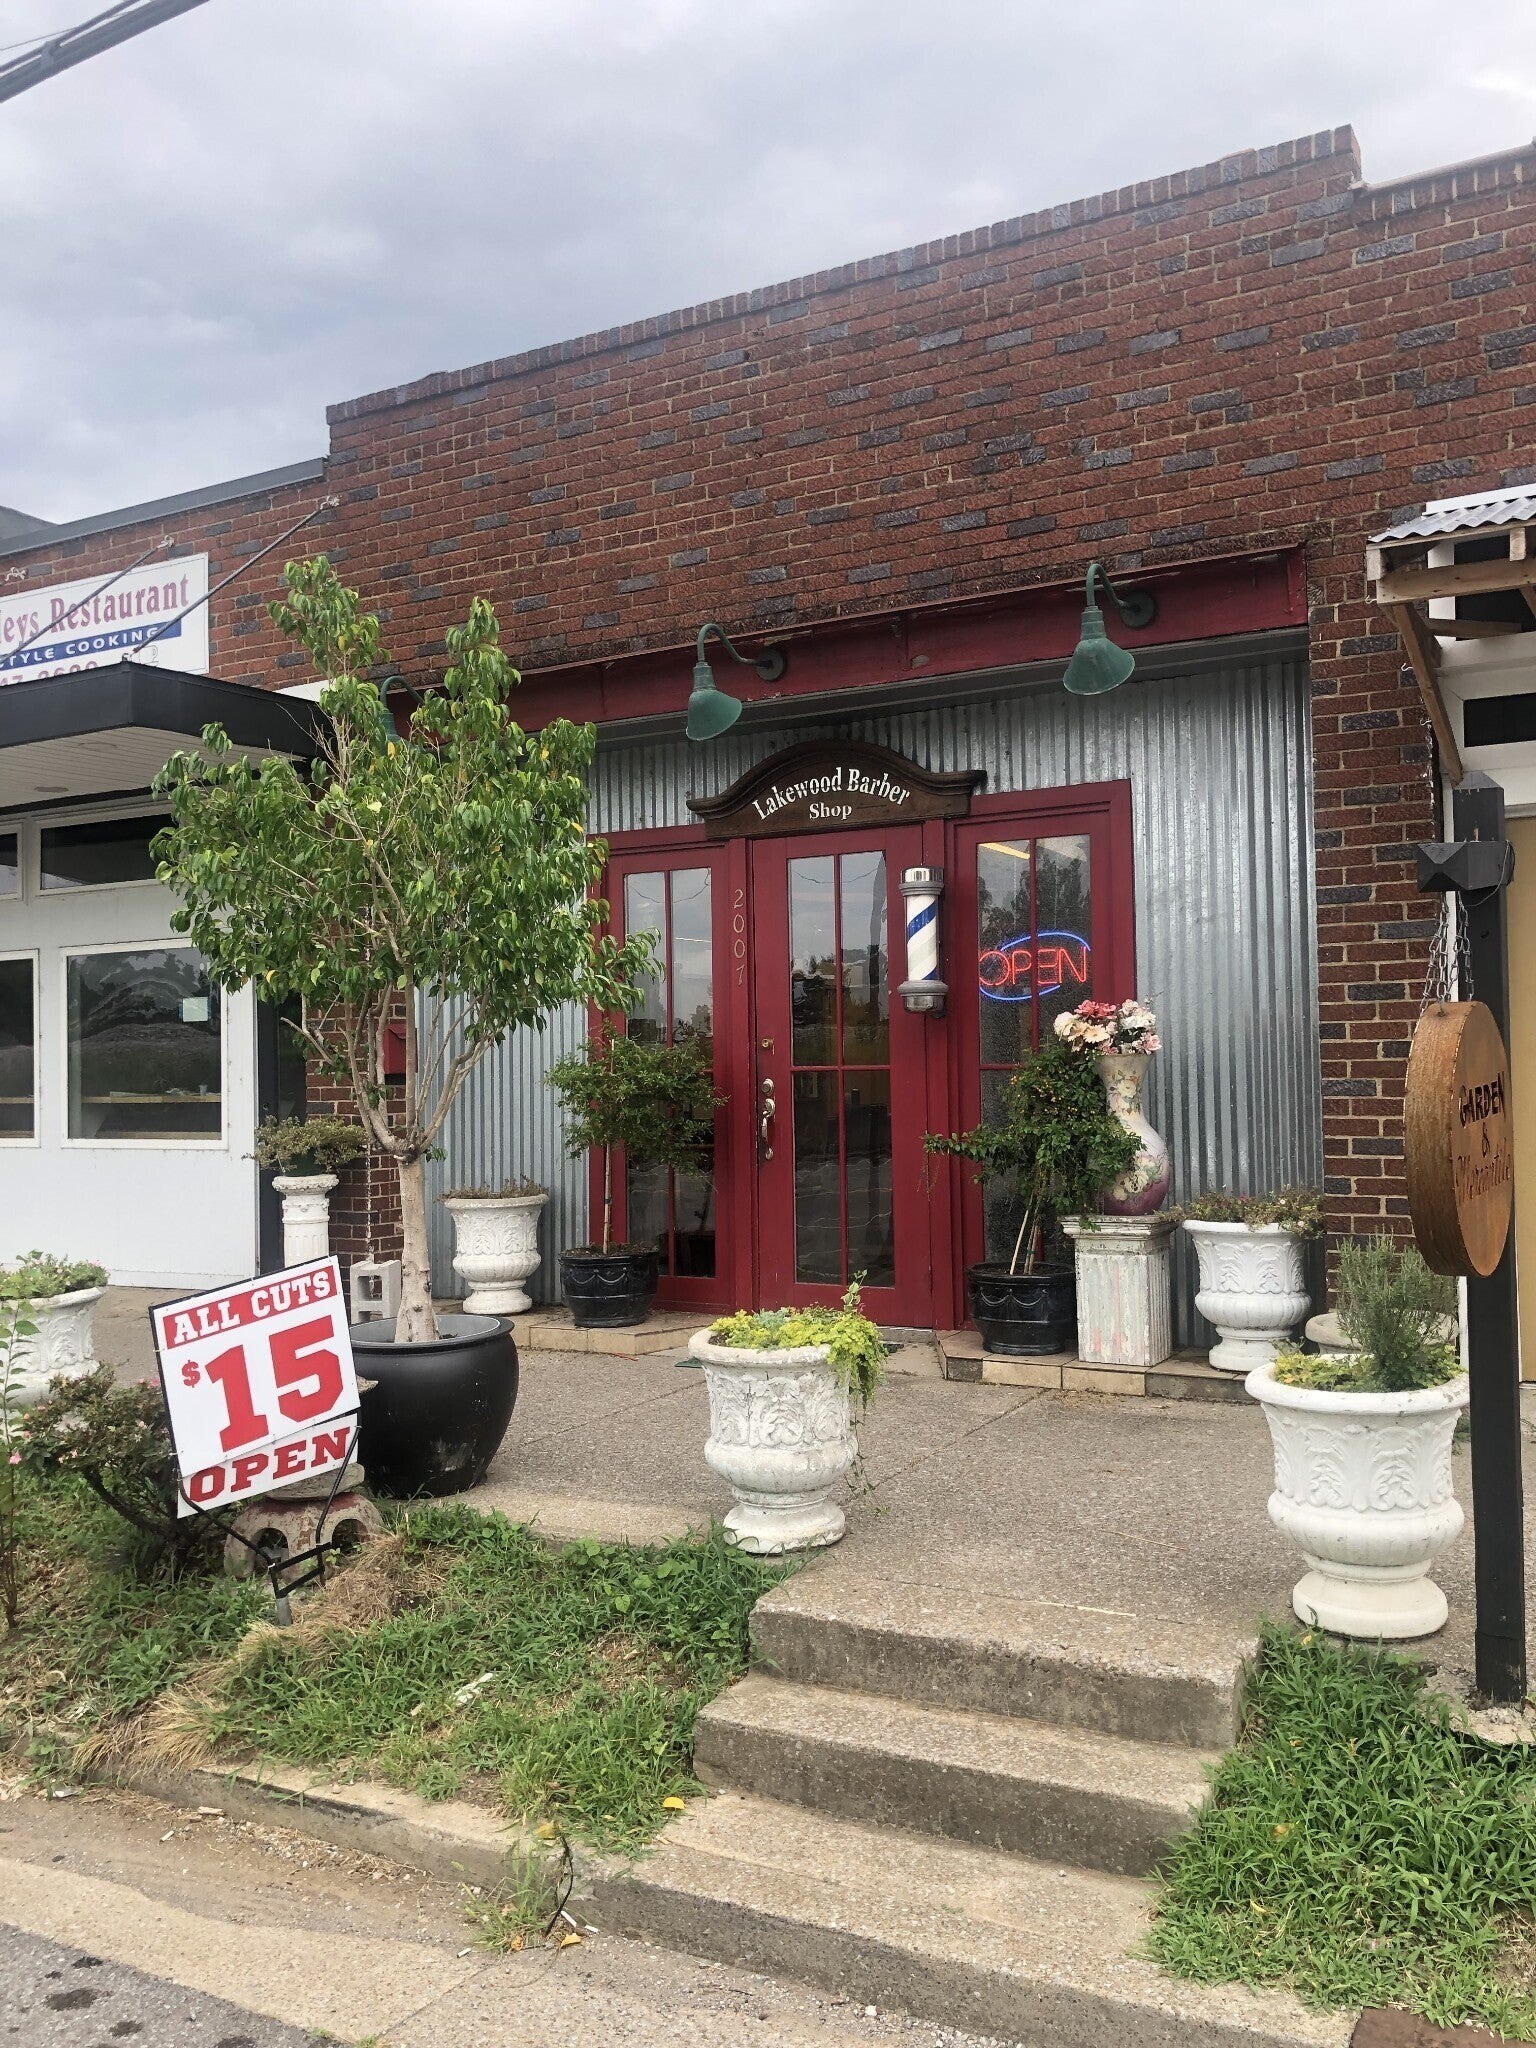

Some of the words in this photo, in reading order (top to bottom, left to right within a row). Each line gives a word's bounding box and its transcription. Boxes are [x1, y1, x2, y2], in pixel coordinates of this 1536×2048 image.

[0, 609, 39, 648] eys
[50, 574, 189, 633] Restaurant
[752, 767, 842, 820] Lakewood
[847, 768, 910, 806] Barber
[809, 802, 852, 820] Shop
[979, 946, 1087, 986] OPEN
[1459, 1070, 1505, 1128] GARDEN
[173, 1300, 240, 1344] ALL
[251, 1271, 330, 1318] CUTS
[189, 1426, 351, 1503] OPEN
